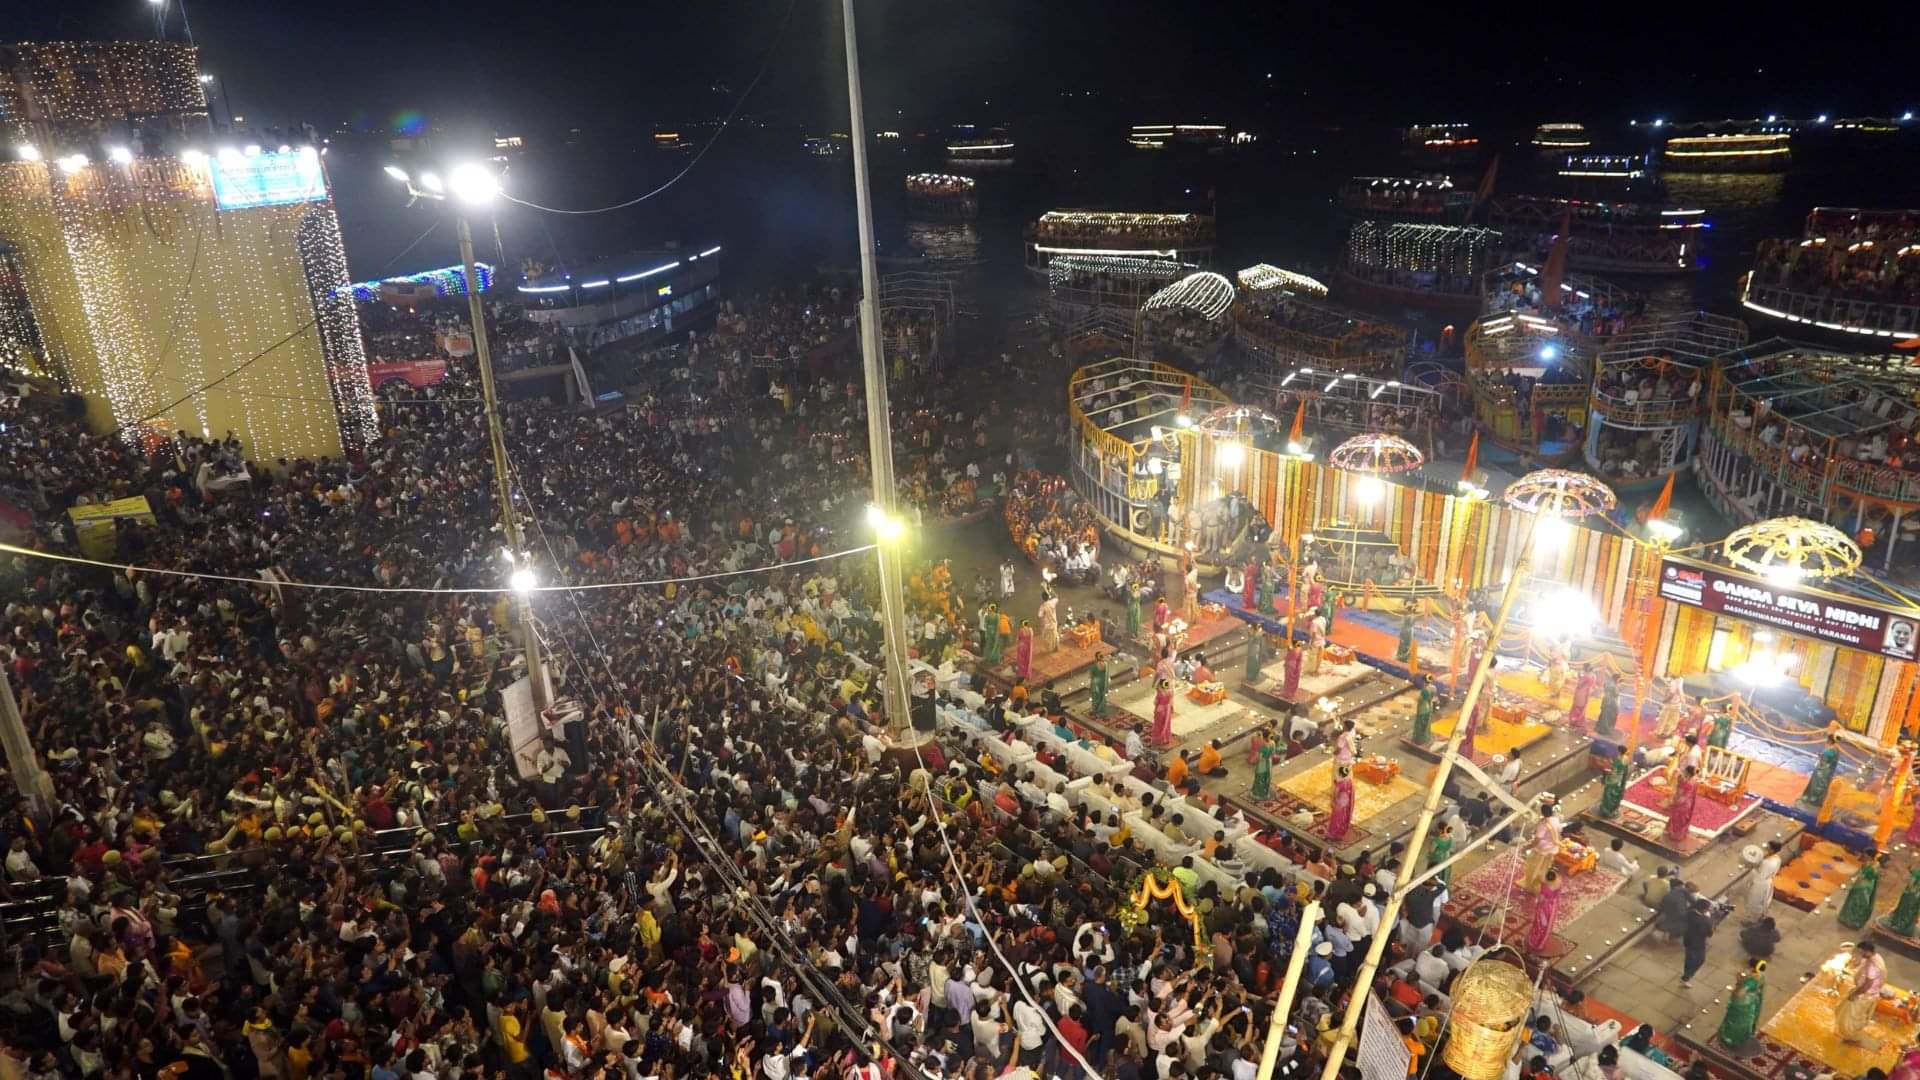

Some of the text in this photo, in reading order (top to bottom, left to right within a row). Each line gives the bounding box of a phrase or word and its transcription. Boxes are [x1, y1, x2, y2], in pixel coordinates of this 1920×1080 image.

[1712, 580, 1773, 605] GANGA
[1777, 595, 1820, 616] SEVA
[1824, 606, 1880, 630] NIDHI
[1723, 604, 1793, 627] DASHASHWAMEDH
[1818, 628, 1860, 643] VARANASI
